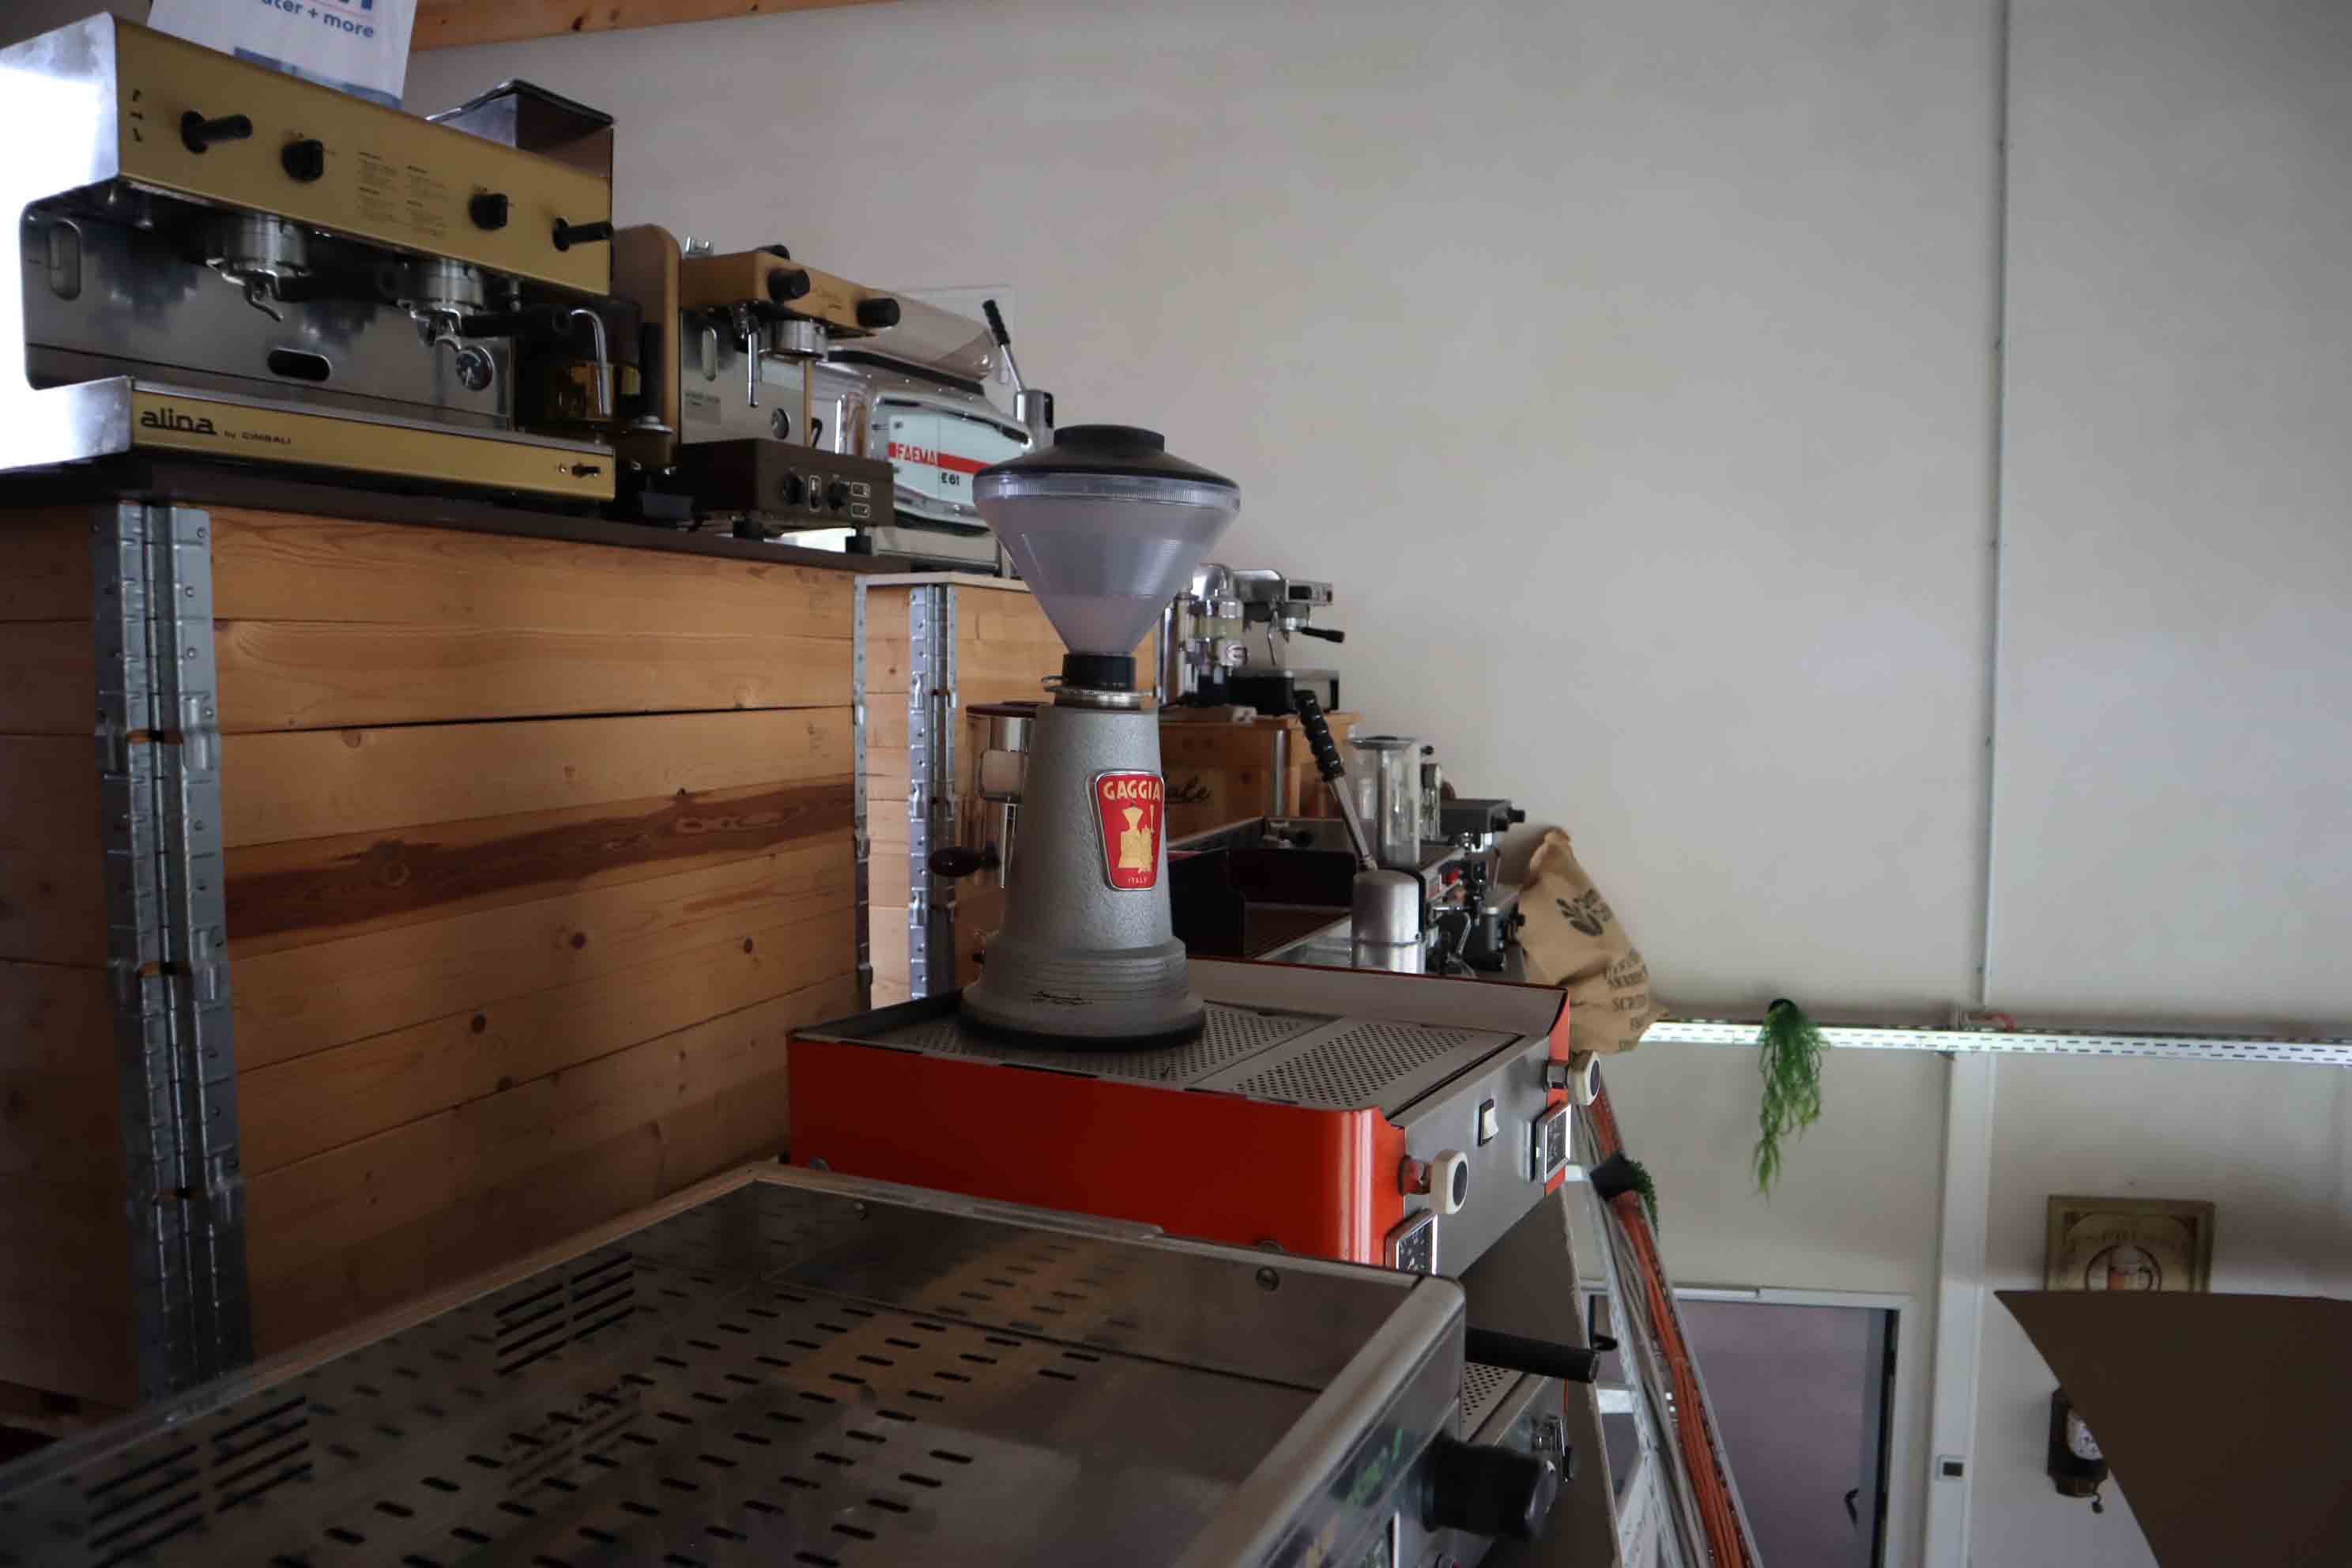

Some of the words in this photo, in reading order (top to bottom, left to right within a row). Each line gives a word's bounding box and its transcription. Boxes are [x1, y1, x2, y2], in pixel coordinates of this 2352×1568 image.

[323, 13, 374, 38] more
[141, 407, 216, 435] alina
[897, 443, 938, 466] FAEMA
[1102, 779, 1161, 801] GAGGIA
[1128, 876, 1148, 886] ITALY
